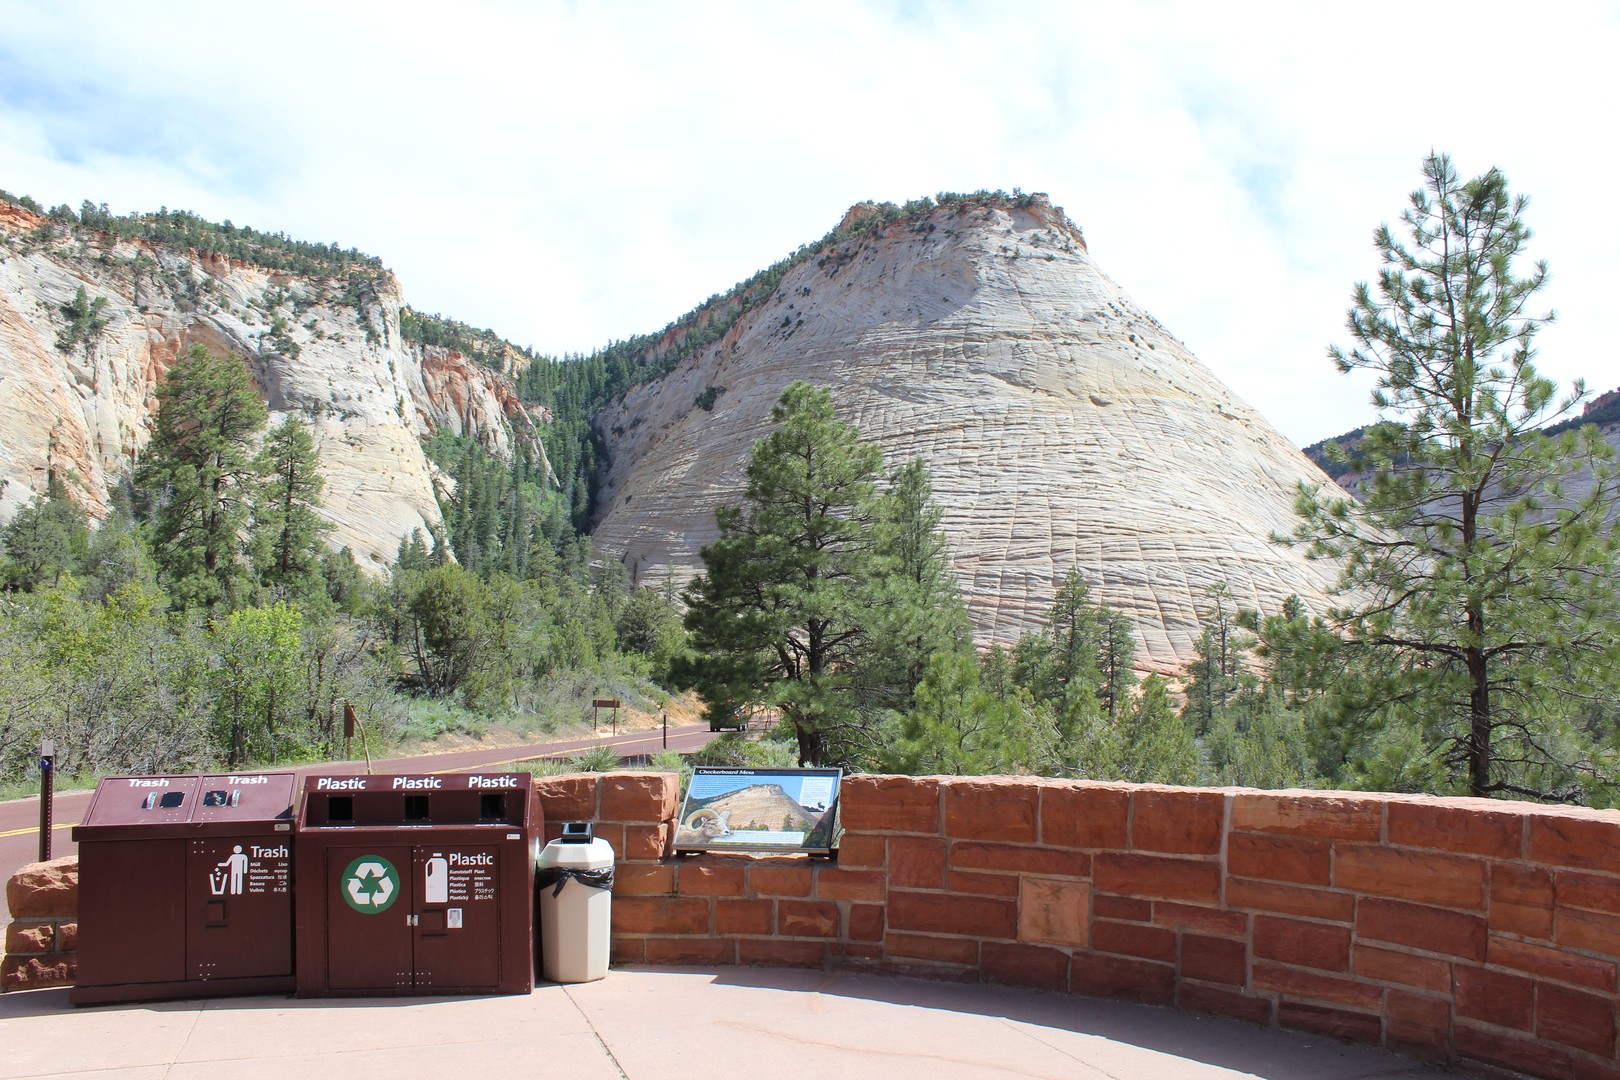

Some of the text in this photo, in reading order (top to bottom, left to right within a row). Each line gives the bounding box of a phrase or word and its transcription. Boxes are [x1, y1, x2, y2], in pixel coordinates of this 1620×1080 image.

[128, 778, 170, 788] Trash
[227, 775, 268, 785] Trash
[317, 777, 367, 790] Plastic
[392, 776, 442, 789] Plastic
[468, 775, 517, 788] Plastic
[250, 845, 288, 858] Trash
[449, 852, 494, 866] Plastic
